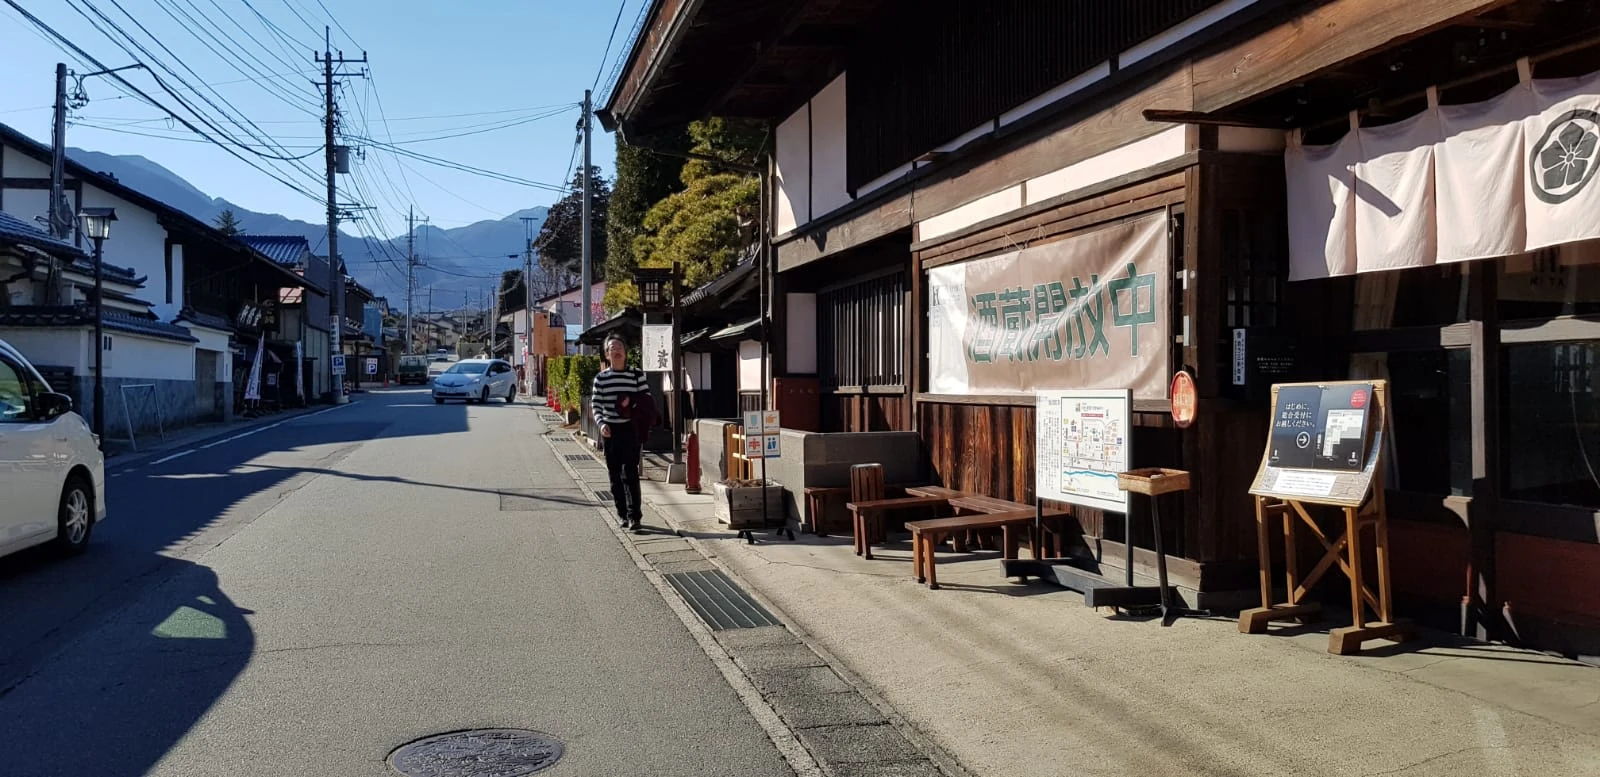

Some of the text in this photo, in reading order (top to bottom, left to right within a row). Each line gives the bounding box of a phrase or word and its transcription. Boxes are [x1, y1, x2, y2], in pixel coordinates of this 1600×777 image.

[967, 261, 1157, 363] 酒蔵開放中
[368, 364, 376, 374] P
[1285, 402, 1310, 410] はじめに、
[1281, 411, 1312, 419] 総合受付に
[1276, 419, 1315, 428] お越しください。
